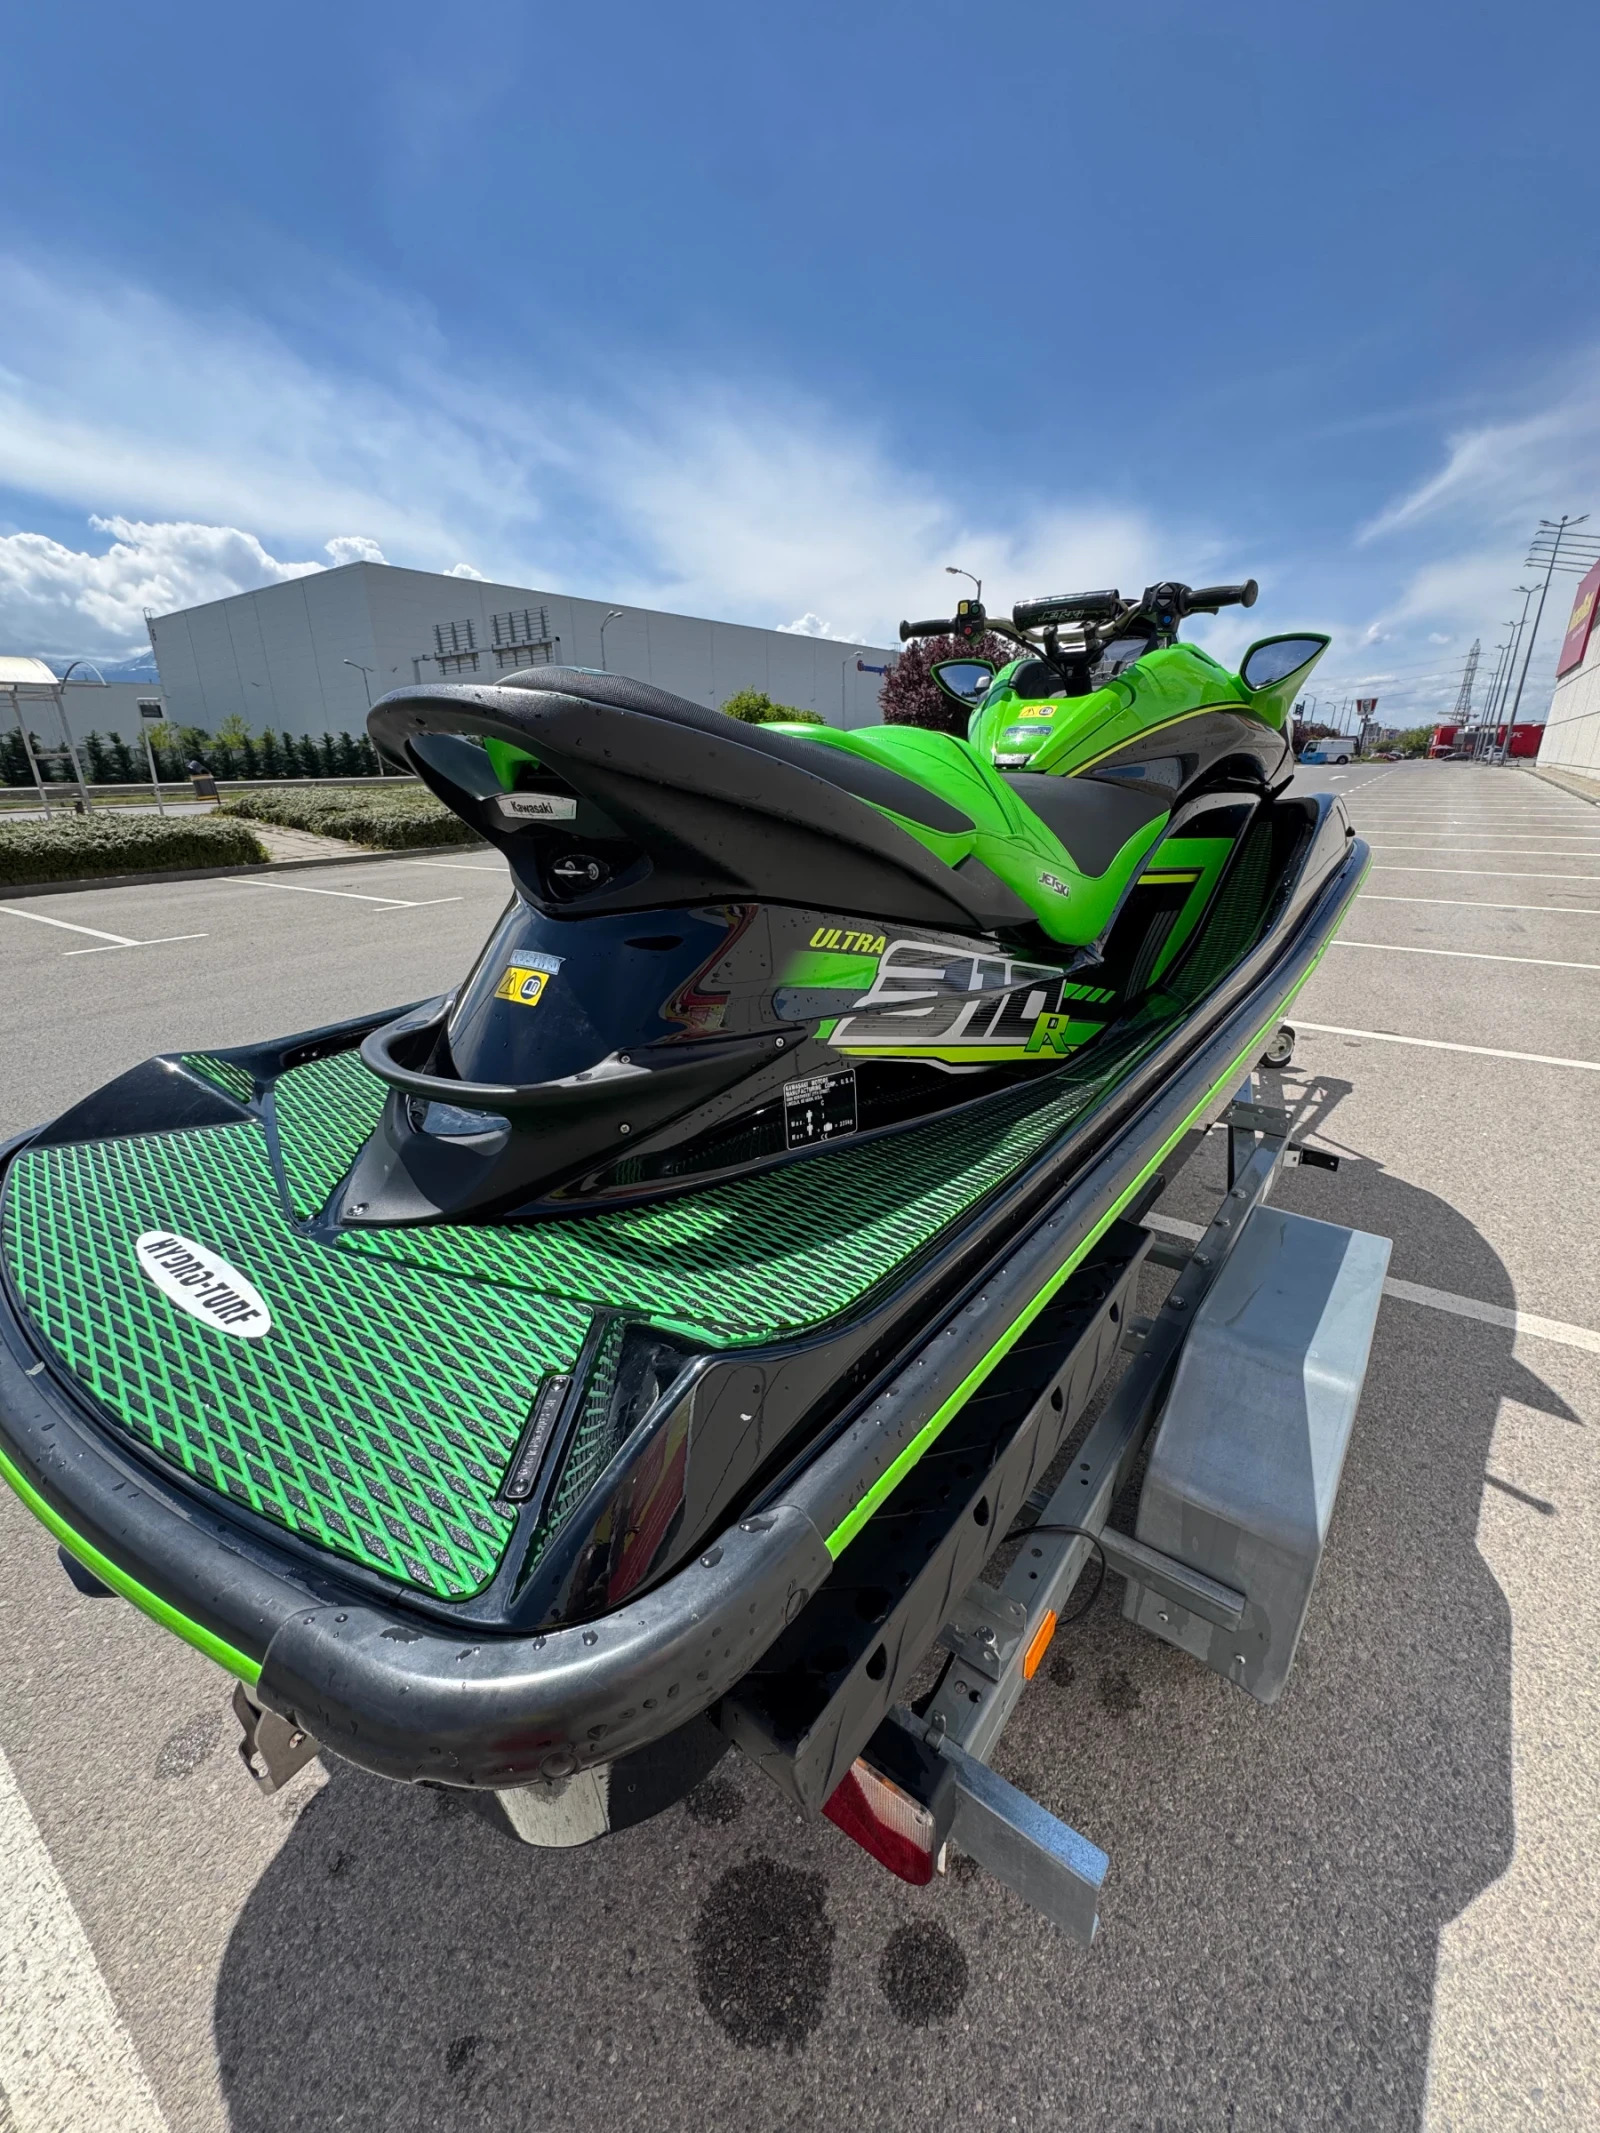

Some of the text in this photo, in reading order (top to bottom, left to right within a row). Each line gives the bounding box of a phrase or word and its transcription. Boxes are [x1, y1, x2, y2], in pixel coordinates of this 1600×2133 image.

[510, 800, 554, 814] Kawasaki
[809, 927, 887, 954] ULTRA
[1023, 1011, 1072, 1055] R
[786, 1081, 808, 1091] KAWASAKI
[143, 1238, 262, 1325] HYDRO-TURF
